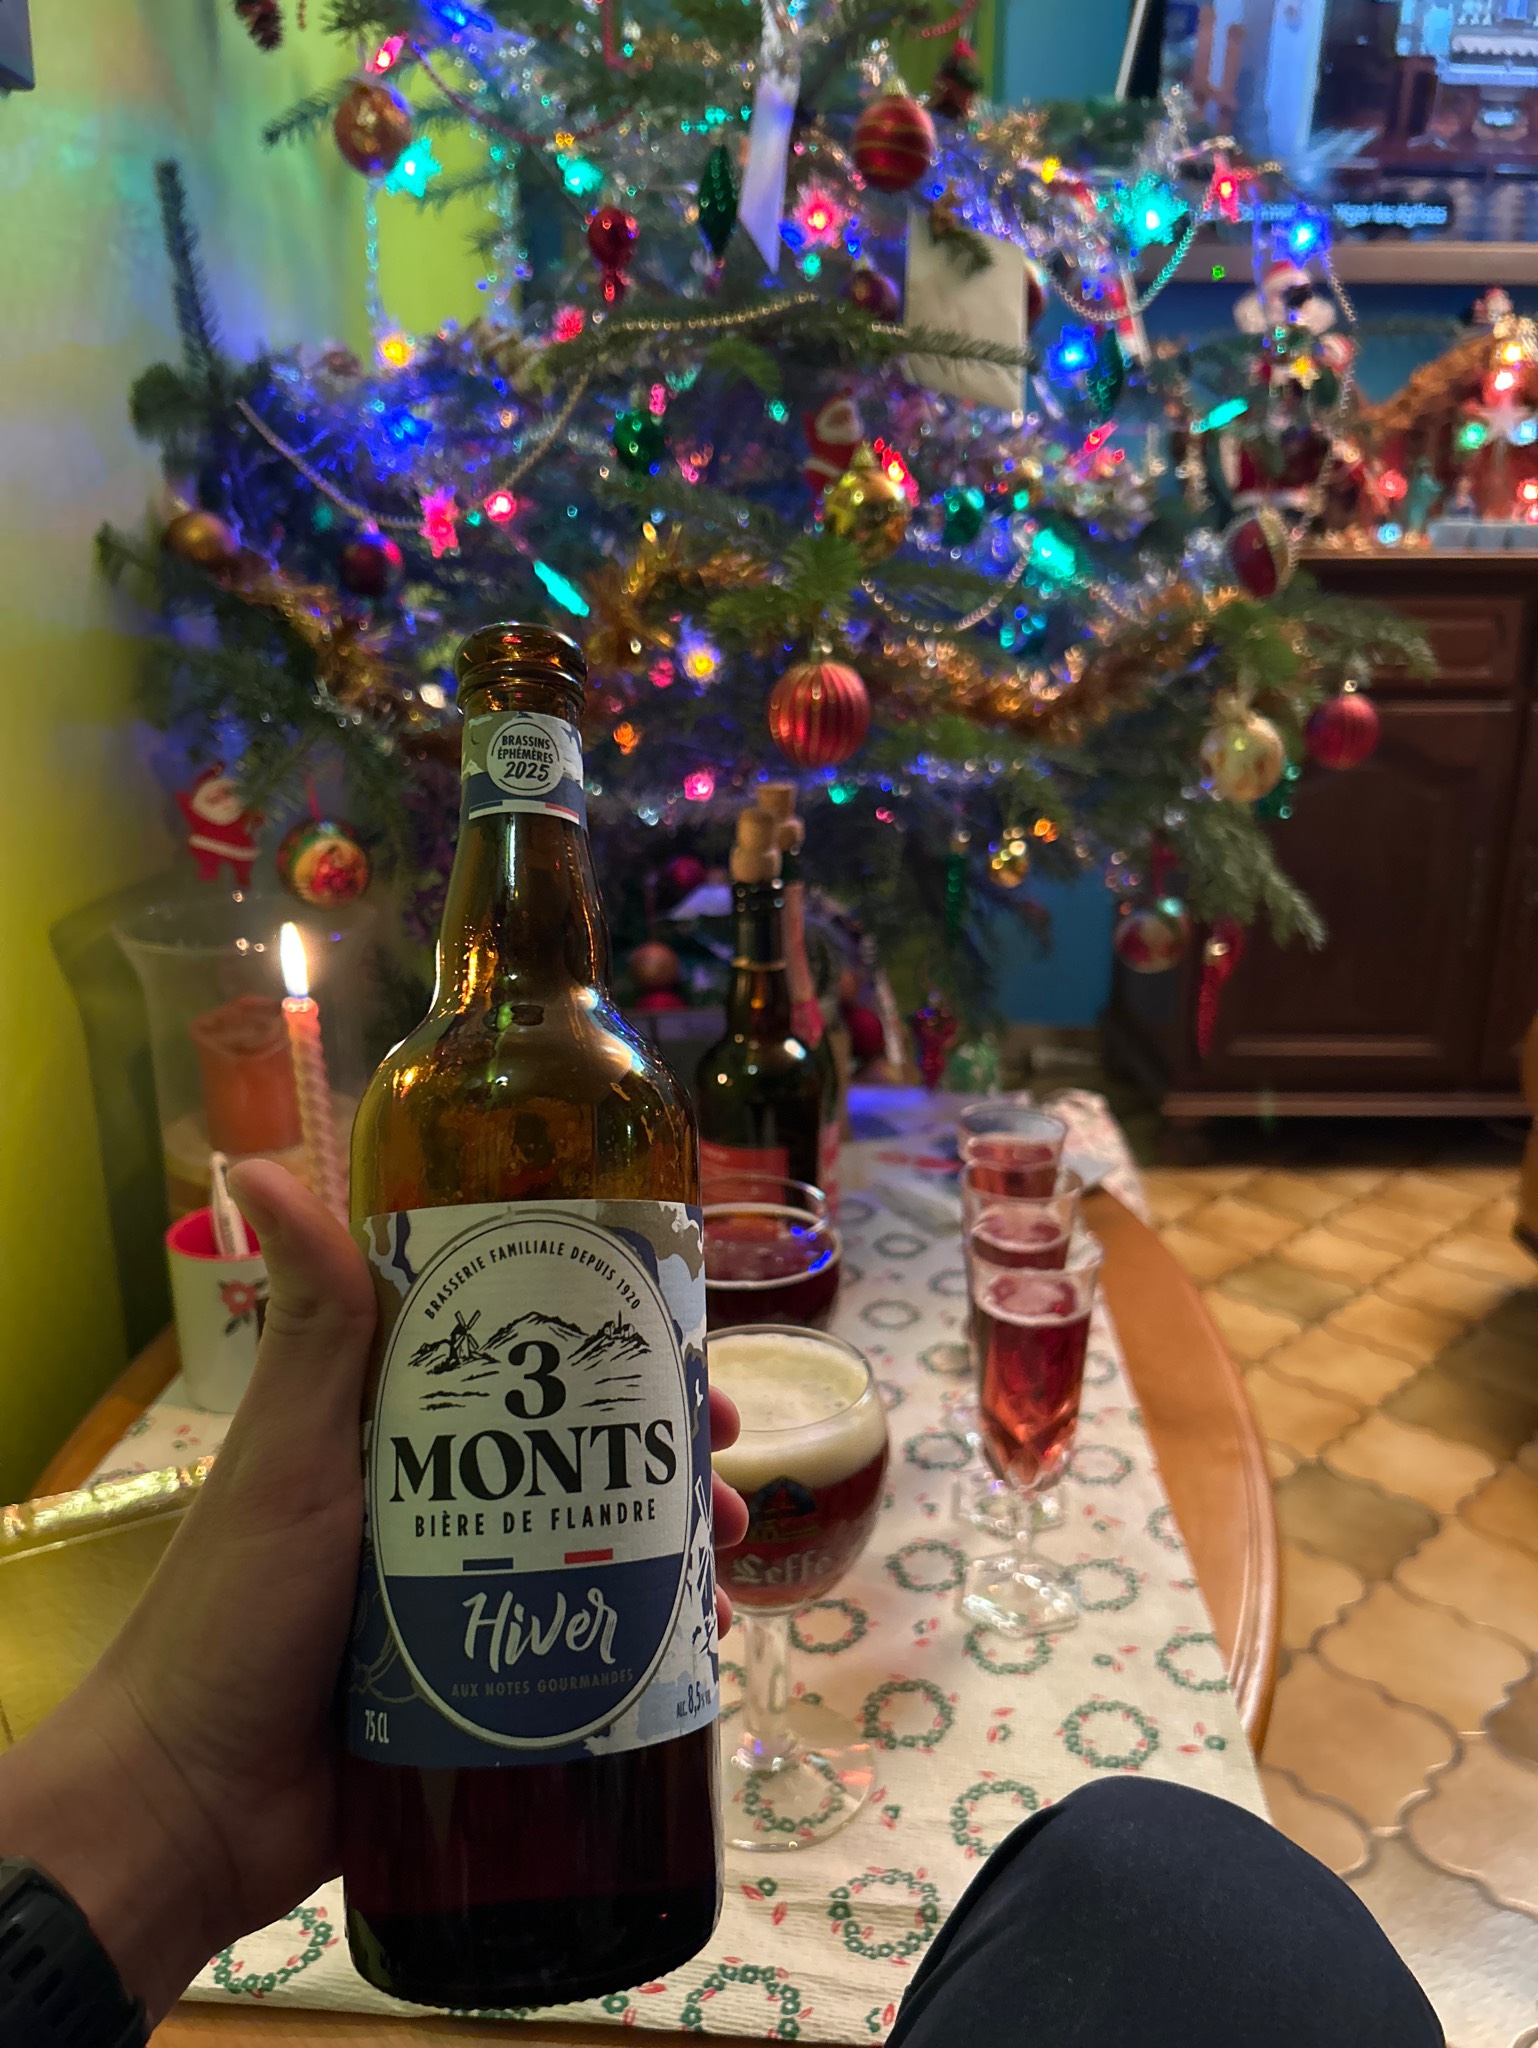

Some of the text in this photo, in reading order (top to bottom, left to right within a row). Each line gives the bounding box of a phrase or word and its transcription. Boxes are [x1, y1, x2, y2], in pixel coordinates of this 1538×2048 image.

[497, 745, 554, 764] ÉPHÉMÈRES
[501, 734, 551, 749] BRASSINS
[503, 761, 551, 782] 2025
[424, 1240, 642, 1320] BRASSERIE FAMILIALE DEPUIS 1920
[504, 1340, 567, 1419] 3
[389, 1419, 677, 1503] MONTS
[415, 1498, 656, 1538] BIÈRE DE FLANDRE
[462, 1587, 618, 1673] Hiver
[451, 1668, 634, 1697] AUX NOTES GOURMANDES
